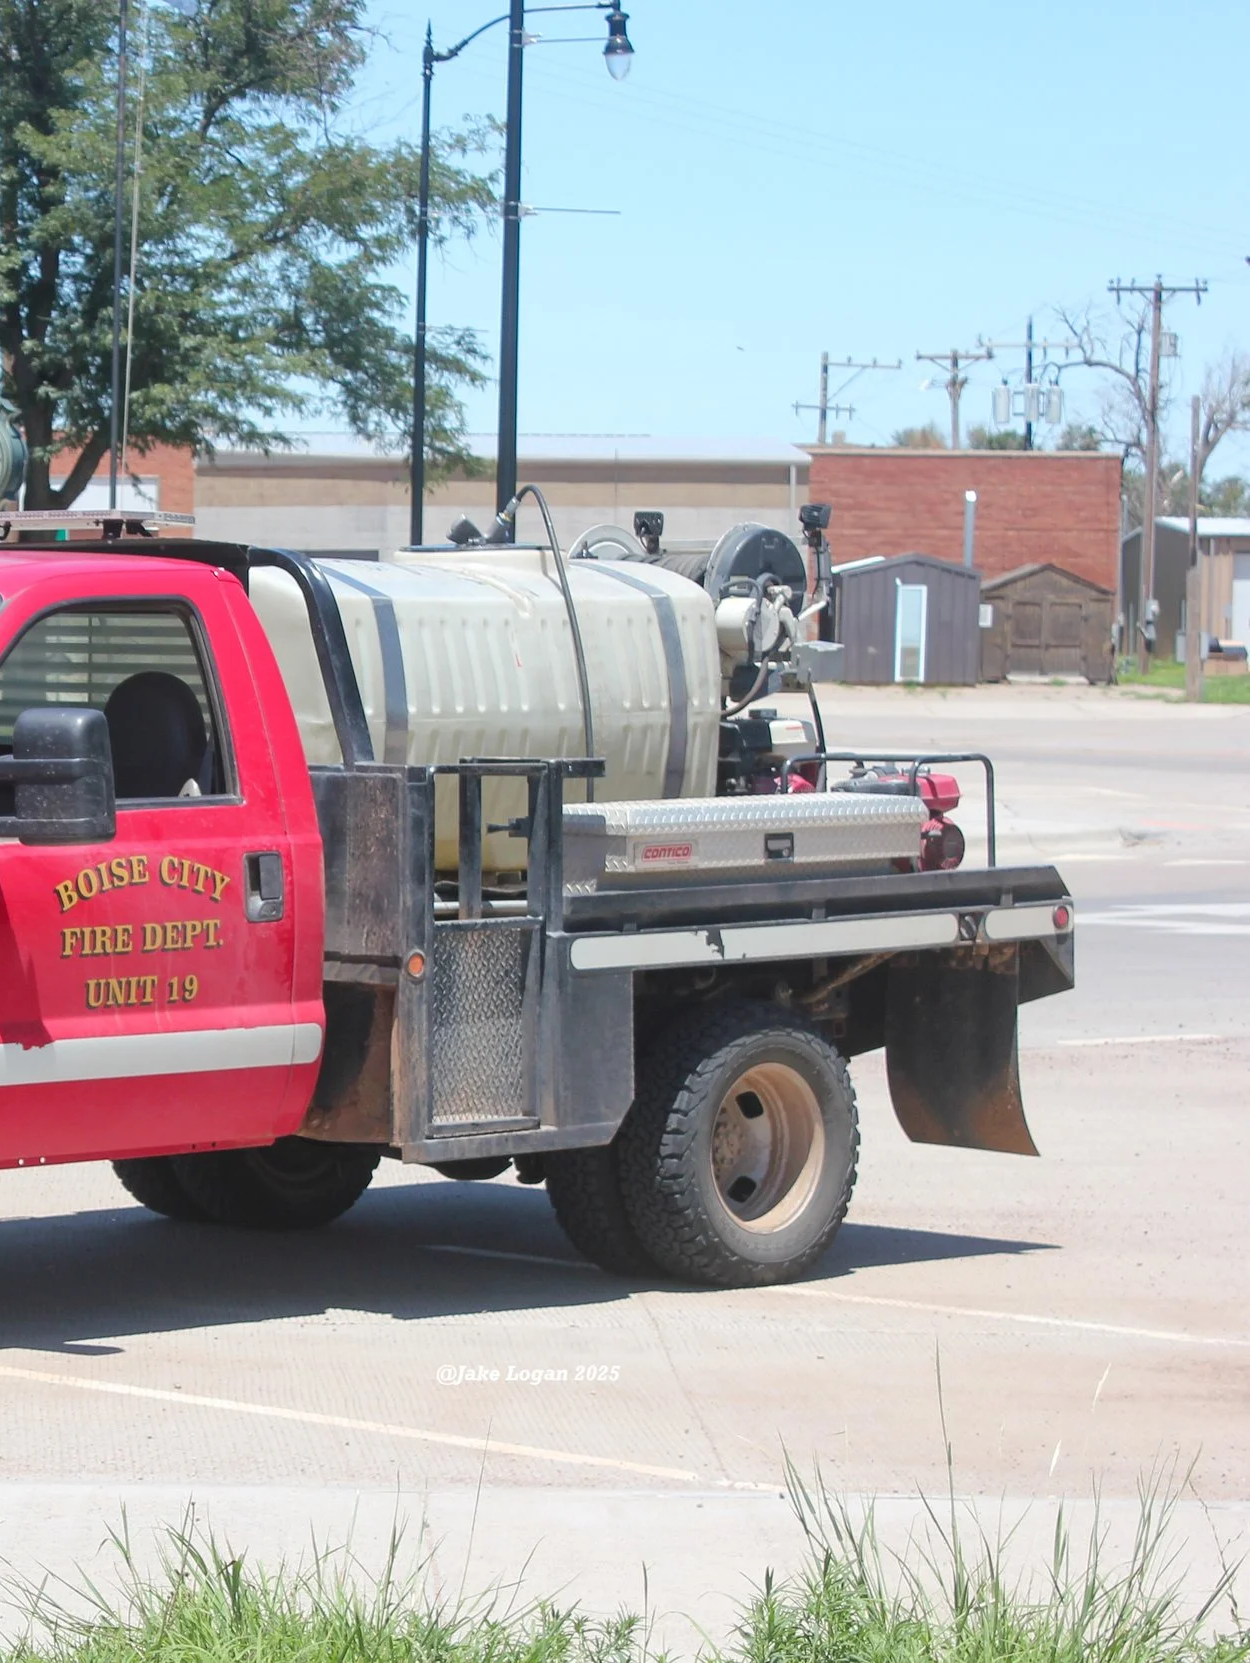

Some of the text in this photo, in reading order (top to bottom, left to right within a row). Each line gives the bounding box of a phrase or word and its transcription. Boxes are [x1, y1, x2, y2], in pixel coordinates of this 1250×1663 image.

[643, 846, 690, 859] CONTICO
[55, 855, 230, 913] BOISE CITY
[62, 919, 223, 957] FIRE DEPT.
[87, 974, 198, 1008] UNIT 19
